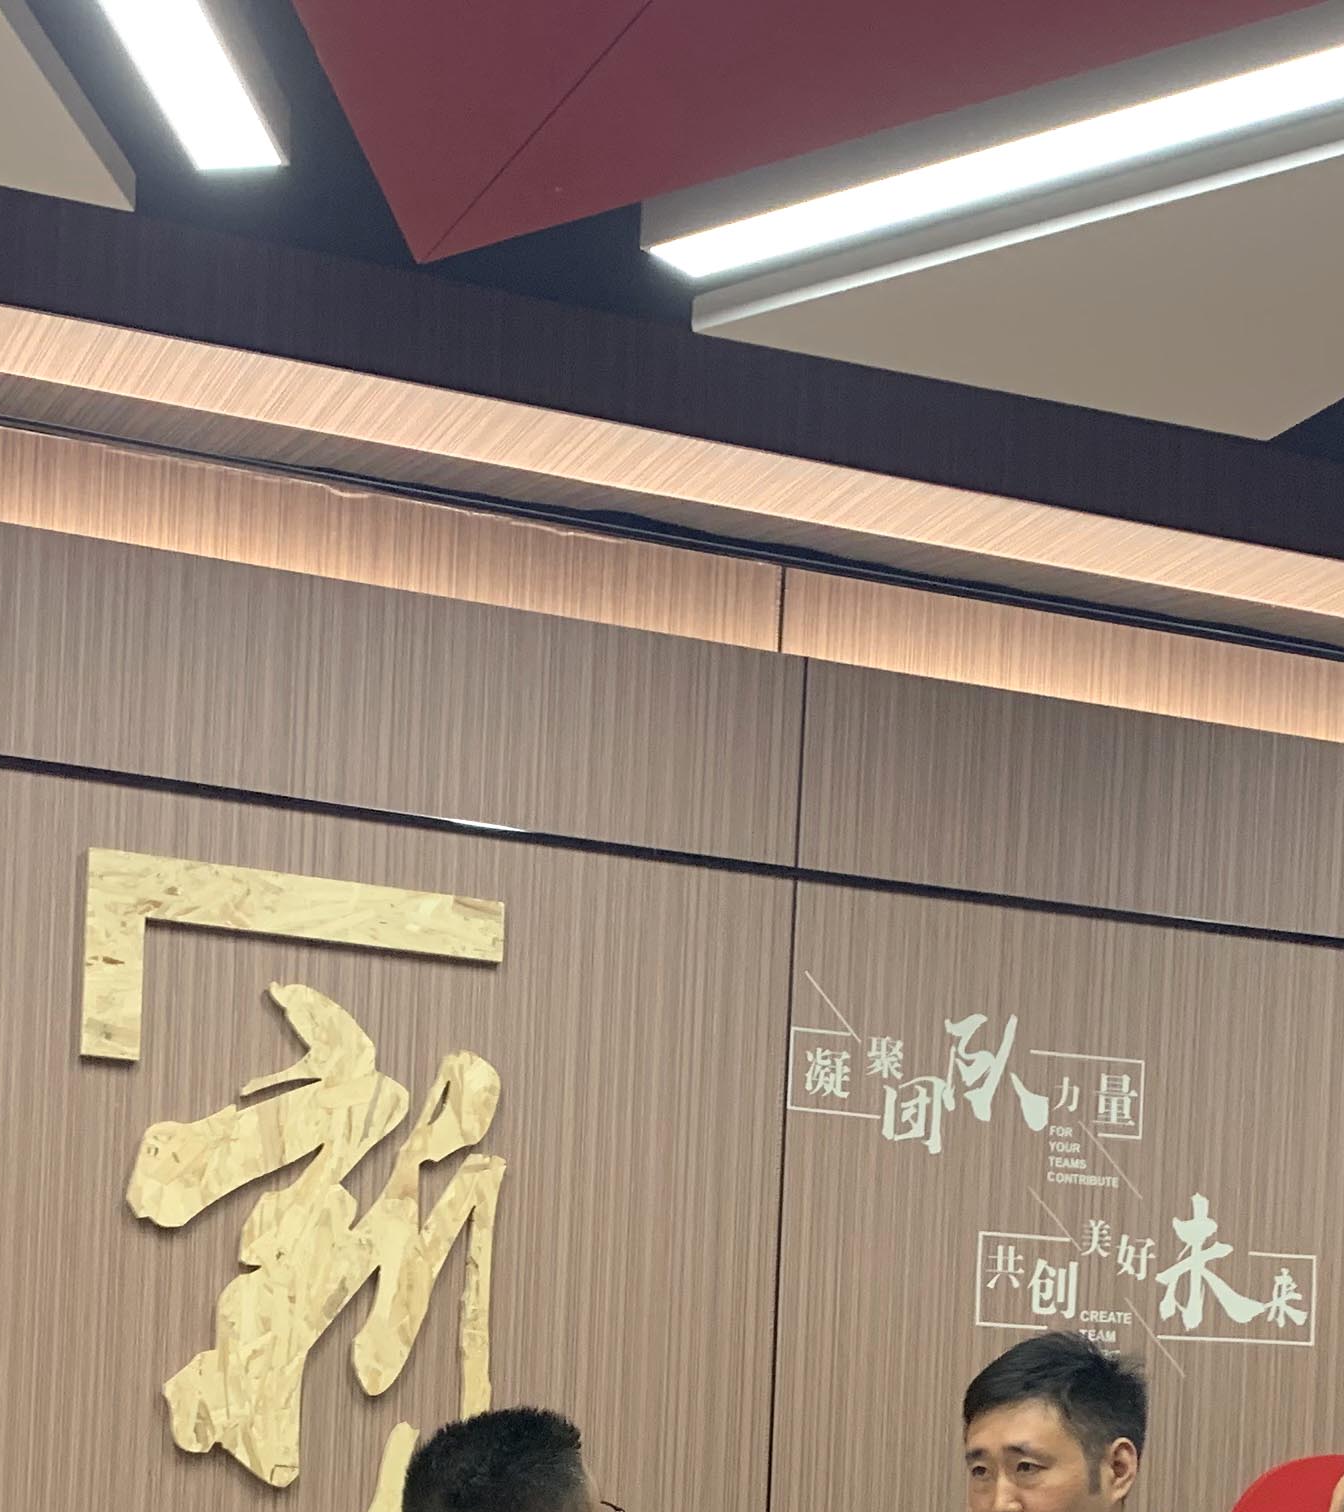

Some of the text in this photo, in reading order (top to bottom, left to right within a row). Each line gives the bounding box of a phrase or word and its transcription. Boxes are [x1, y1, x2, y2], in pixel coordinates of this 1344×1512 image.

[1049, 1125, 1073, 1138] FOR
[1048, 1140, 1081, 1153] YOUR
[1047, 1155, 1088, 1169] TEAMS
[1046, 1171, 1120, 1189] CONTRIBUTE
[1079, 1310, 1133, 1325] CREATE
